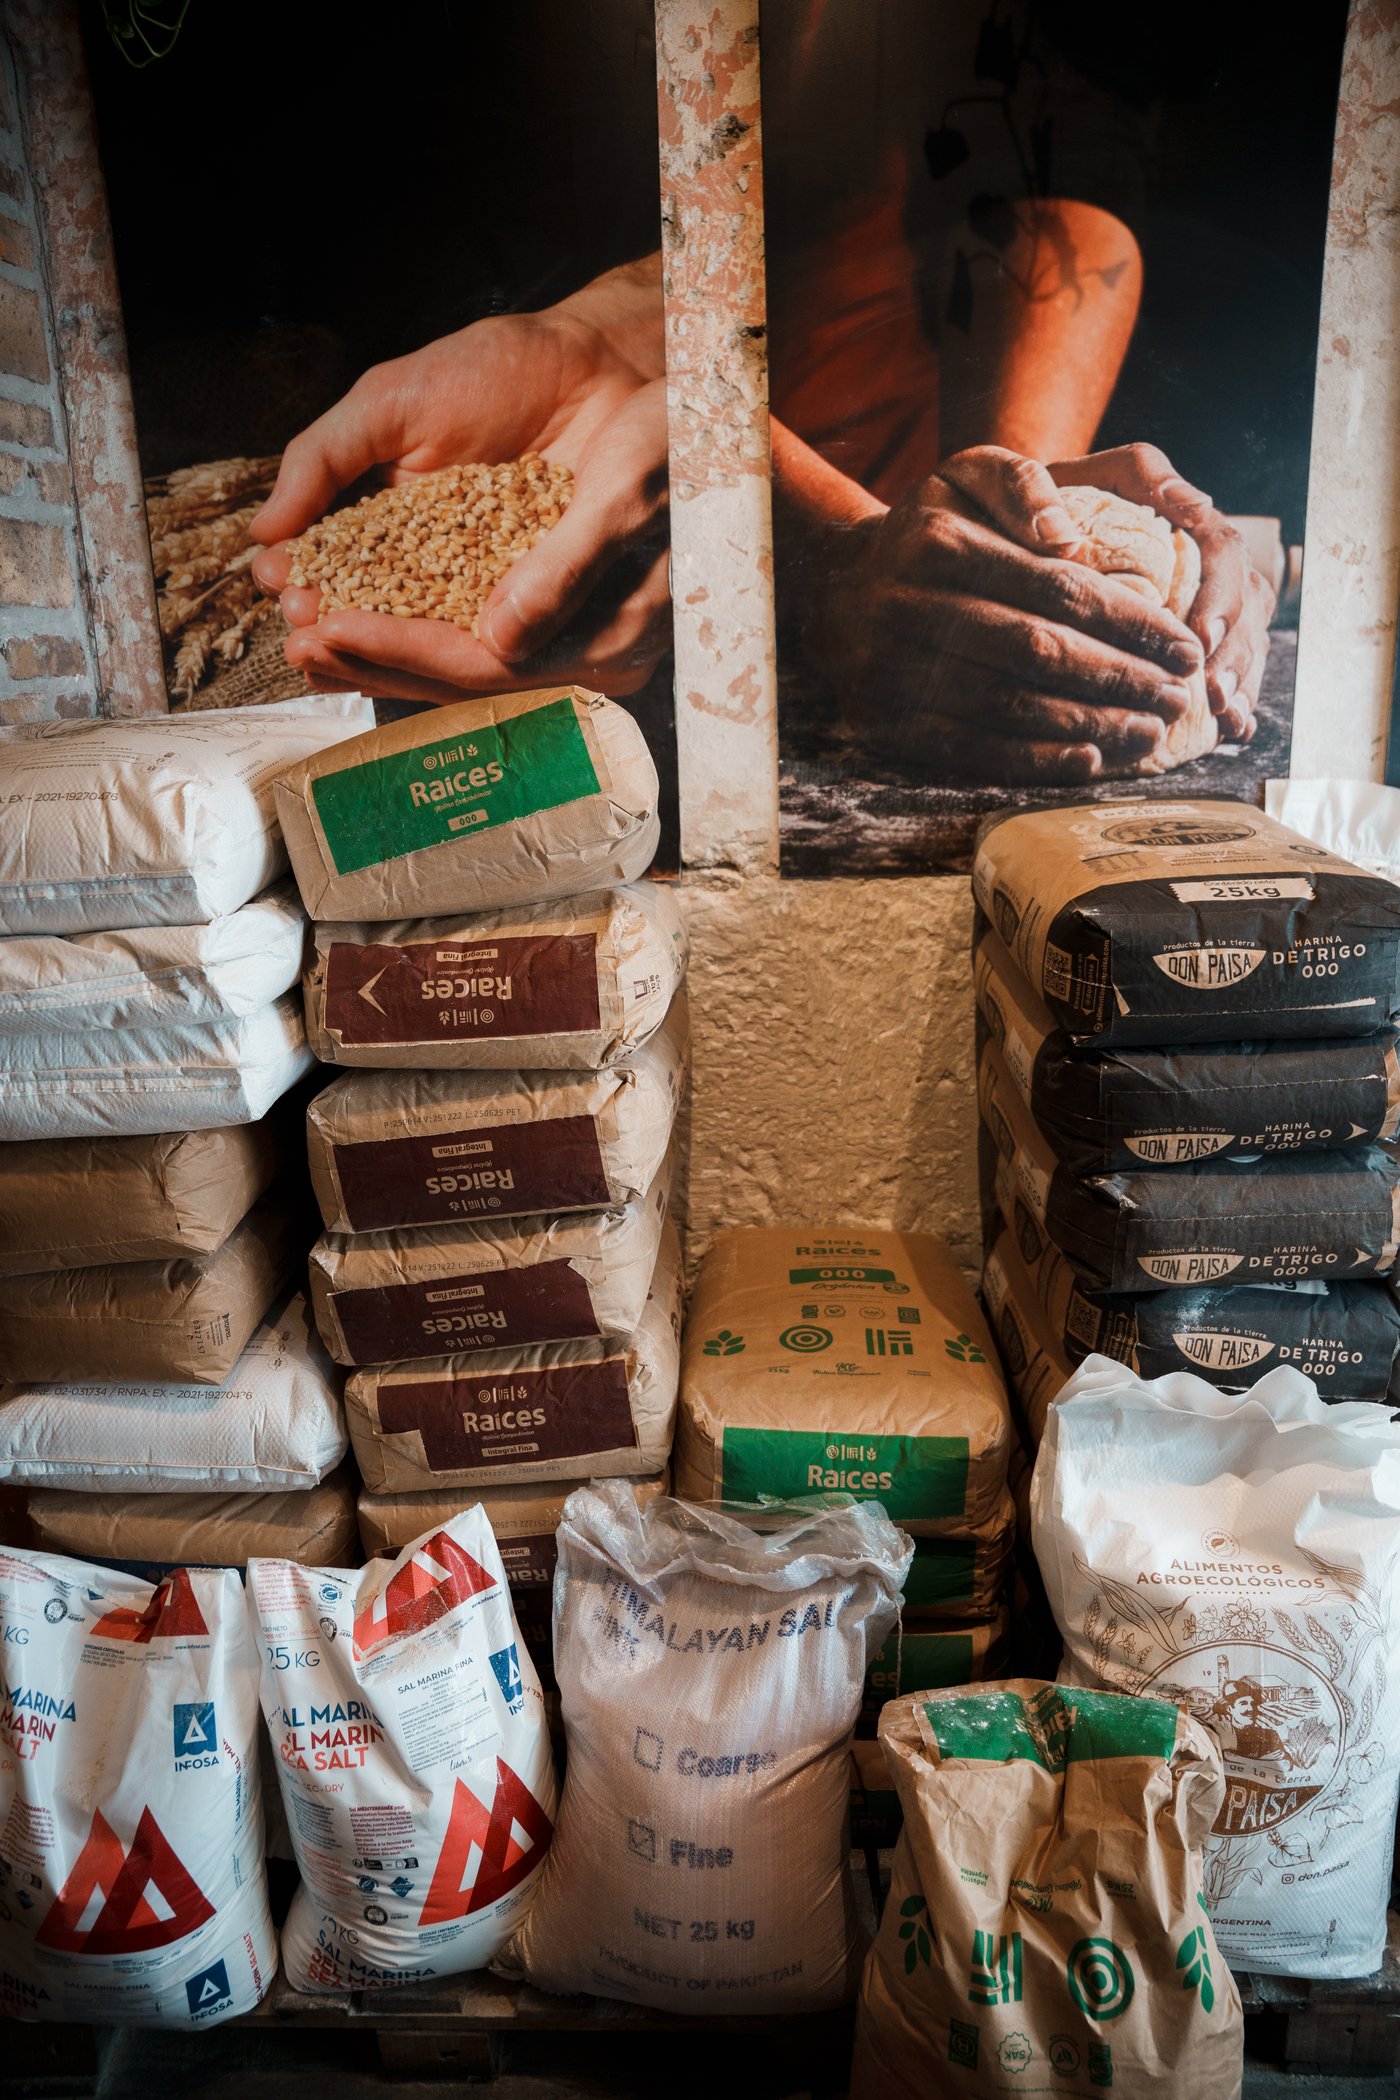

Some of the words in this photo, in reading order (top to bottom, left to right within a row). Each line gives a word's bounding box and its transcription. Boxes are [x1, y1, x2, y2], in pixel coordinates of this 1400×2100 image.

[35, 792, 119, 802] 2021-19270476
[1211, 885, 1281, 899] 25kg
[1163, 941, 1201, 951] Productos
[1204, 939, 1213, 948] de
[1217, 939, 1226, 947] la
[1229, 939, 1255, 948] tierra
[1294, 935, 1342, 948] HARINA
[461, 949, 492, 960] Integral
[1272, 950, 1299, 966] DE
[1303, 943, 1367, 962] TRIGO
[1168, 952, 1198, 984] DON
[1208, 950, 1252, 984] PAISA
[1134, 1125, 1173, 1136] Productos
[1176, 1124, 1184, 1132] de
[1188, 1124, 1197, 1132] la
[1200, 1125, 1226, 1134] tierra
[1265, 1121, 1310, 1132] HARINA
[1240, 1134, 1264, 1146] DE
[1269, 1128, 1332, 1143] TRIGO
[438, 1146, 454, 1156] Fina
[455, 1143, 486, 1154] Integral
[1138, 1137, 1167, 1160] DON
[1175, 1136, 1219, 1160] PAISA
[1148, 1247, 1185, 1255] Productos
[1212, 1246, 1236, 1254] tierra
[1273, 1245, 1317, 1254] HARINA
[1151, 1258, 1179, 1280] DON
[1188, 1257, 1229, 1280] PAISA
[1248, 1256, 1273, 1268] DE
[1279, 1253, 1338, 1266] TRIGO
[432, 1291, 447, 1300] Fina
[448, 1286, 479, 1298] Integral
[1222, 1326, 1231, 1334] de
[1234, 1327, 1242, 1335] la
[1246, 1329, 1267, 1340] tierra
[1302, 1337, 1343, 1349] HARINA
[1184, 1337, 1212, 1360] DON
[1219, 1340, 1260, 1366] PAISA
[1279, 1346, 1302, 1359] DE
[1307, 1348, 1363, 1364] TRIGO
[54, 1387, 107, 1397] 02-031734
[117, 1388, 150, 1398] RNPA:
[152, 1389, 168, 1398] EX
[488, 1447, 517, 1456] Integral
[518, 1445, 533, 1453] Fina
[498, 1549, 525, 1557] Integr
[1170, 1558, 1284, 1575] ALIMENTOS
[505, 1568, 549, 1583] Rai
[1136, 1570, 1326, 1589] AGROECOLÓGICOS
[3, 1626, 30, 1646] KG
[295, 1650, 320, 1668] KG
[398, 1683, 416, 1695] SAL
[417, 1667, 453, 1686] MARINA
[455, 1657, 474, 1671] FINA
[282, 1707, 305, 1728] AL
[310, 1724, 385, 1749] MARIN
[174, 1755, 220, 1773] INFOSA
[314, 1746, 369, 1772] SALT
[676, 1747, 778, 1778] Coarse
[1252, 1766, 1267, 1776] la
[1274, 1773, 1311, 1785] tierra
[324, 1783, 345, 1793] DRY
[1227, 1785, 1299, 1830] PAISA
[669, 1839, 734, 1870] Fine
[960, 1875, 987, 1888] Industria
[1121, 1883, 1134, 1893] 25
[634, 1907, 683, 1940] NET
[689, 1920, 719, 1943] 25
[726, 1919, 756, 1942] kg
[339, 1926, 360, 1945] KG
[349, 1958, 437, 1979] MARINA
[686, 1978, 711, 1991] OF
[190, 1998, 234, 2022] INFOSA
